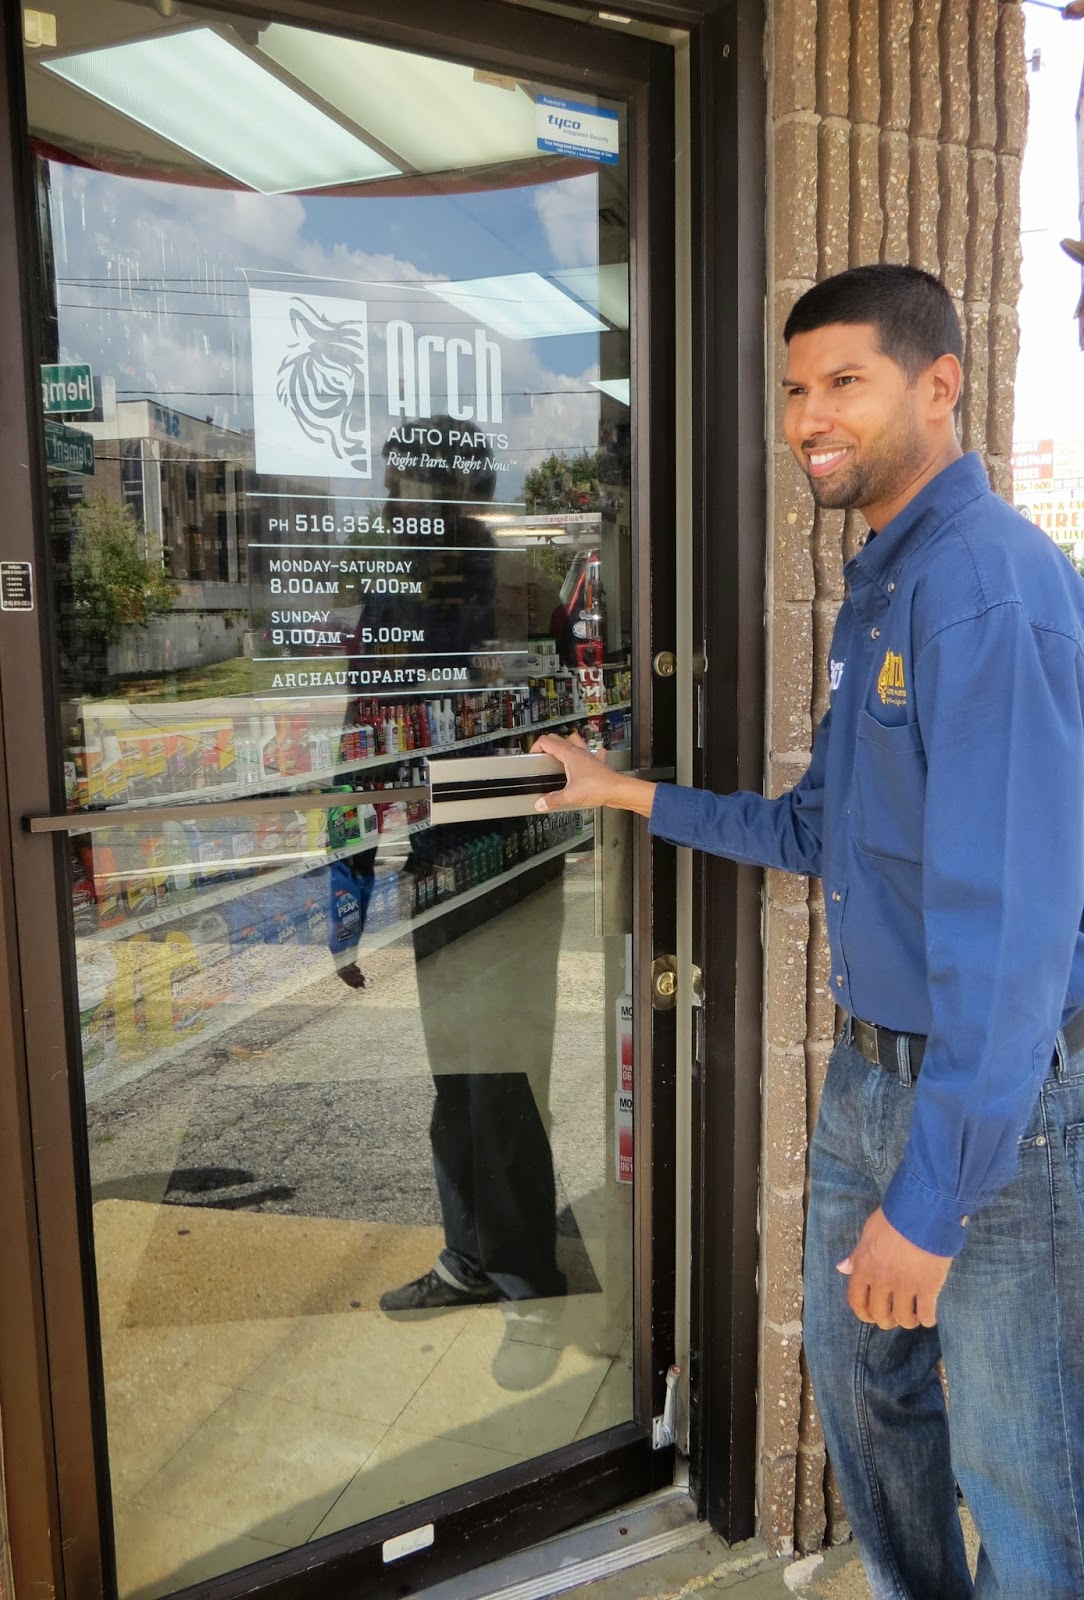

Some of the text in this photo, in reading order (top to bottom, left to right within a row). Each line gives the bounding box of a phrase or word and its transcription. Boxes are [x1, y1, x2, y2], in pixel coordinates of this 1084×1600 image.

[548, 114, 581, 130] tyco
[386, 320, 503, 424] Arch
[387, 426, 509, 449] AUTO PARTS
[387, 451, 418, 471] Right
[420, 454, 448, 469] Parts.
[452, 455, 481, 474] Right
[1033, 502, 1053, 511] NEW
[269, 514, 446, 535] PH 516.354.3888
[1033, 511, 1084, 528] TIRE
[270, 578, 339, 594] 8.00AM
[361, 578, 422, 594] 7.00PM
[271, 610, 331, 624] SUNDAY
[272, 628, 341, 645] 9.00AM
[361, 627, 425, 643] 5.00PM
[271, 667, 468, 688] ARCHAUTOPARTS.COM
[337, 900, 359, 918] PEAK
